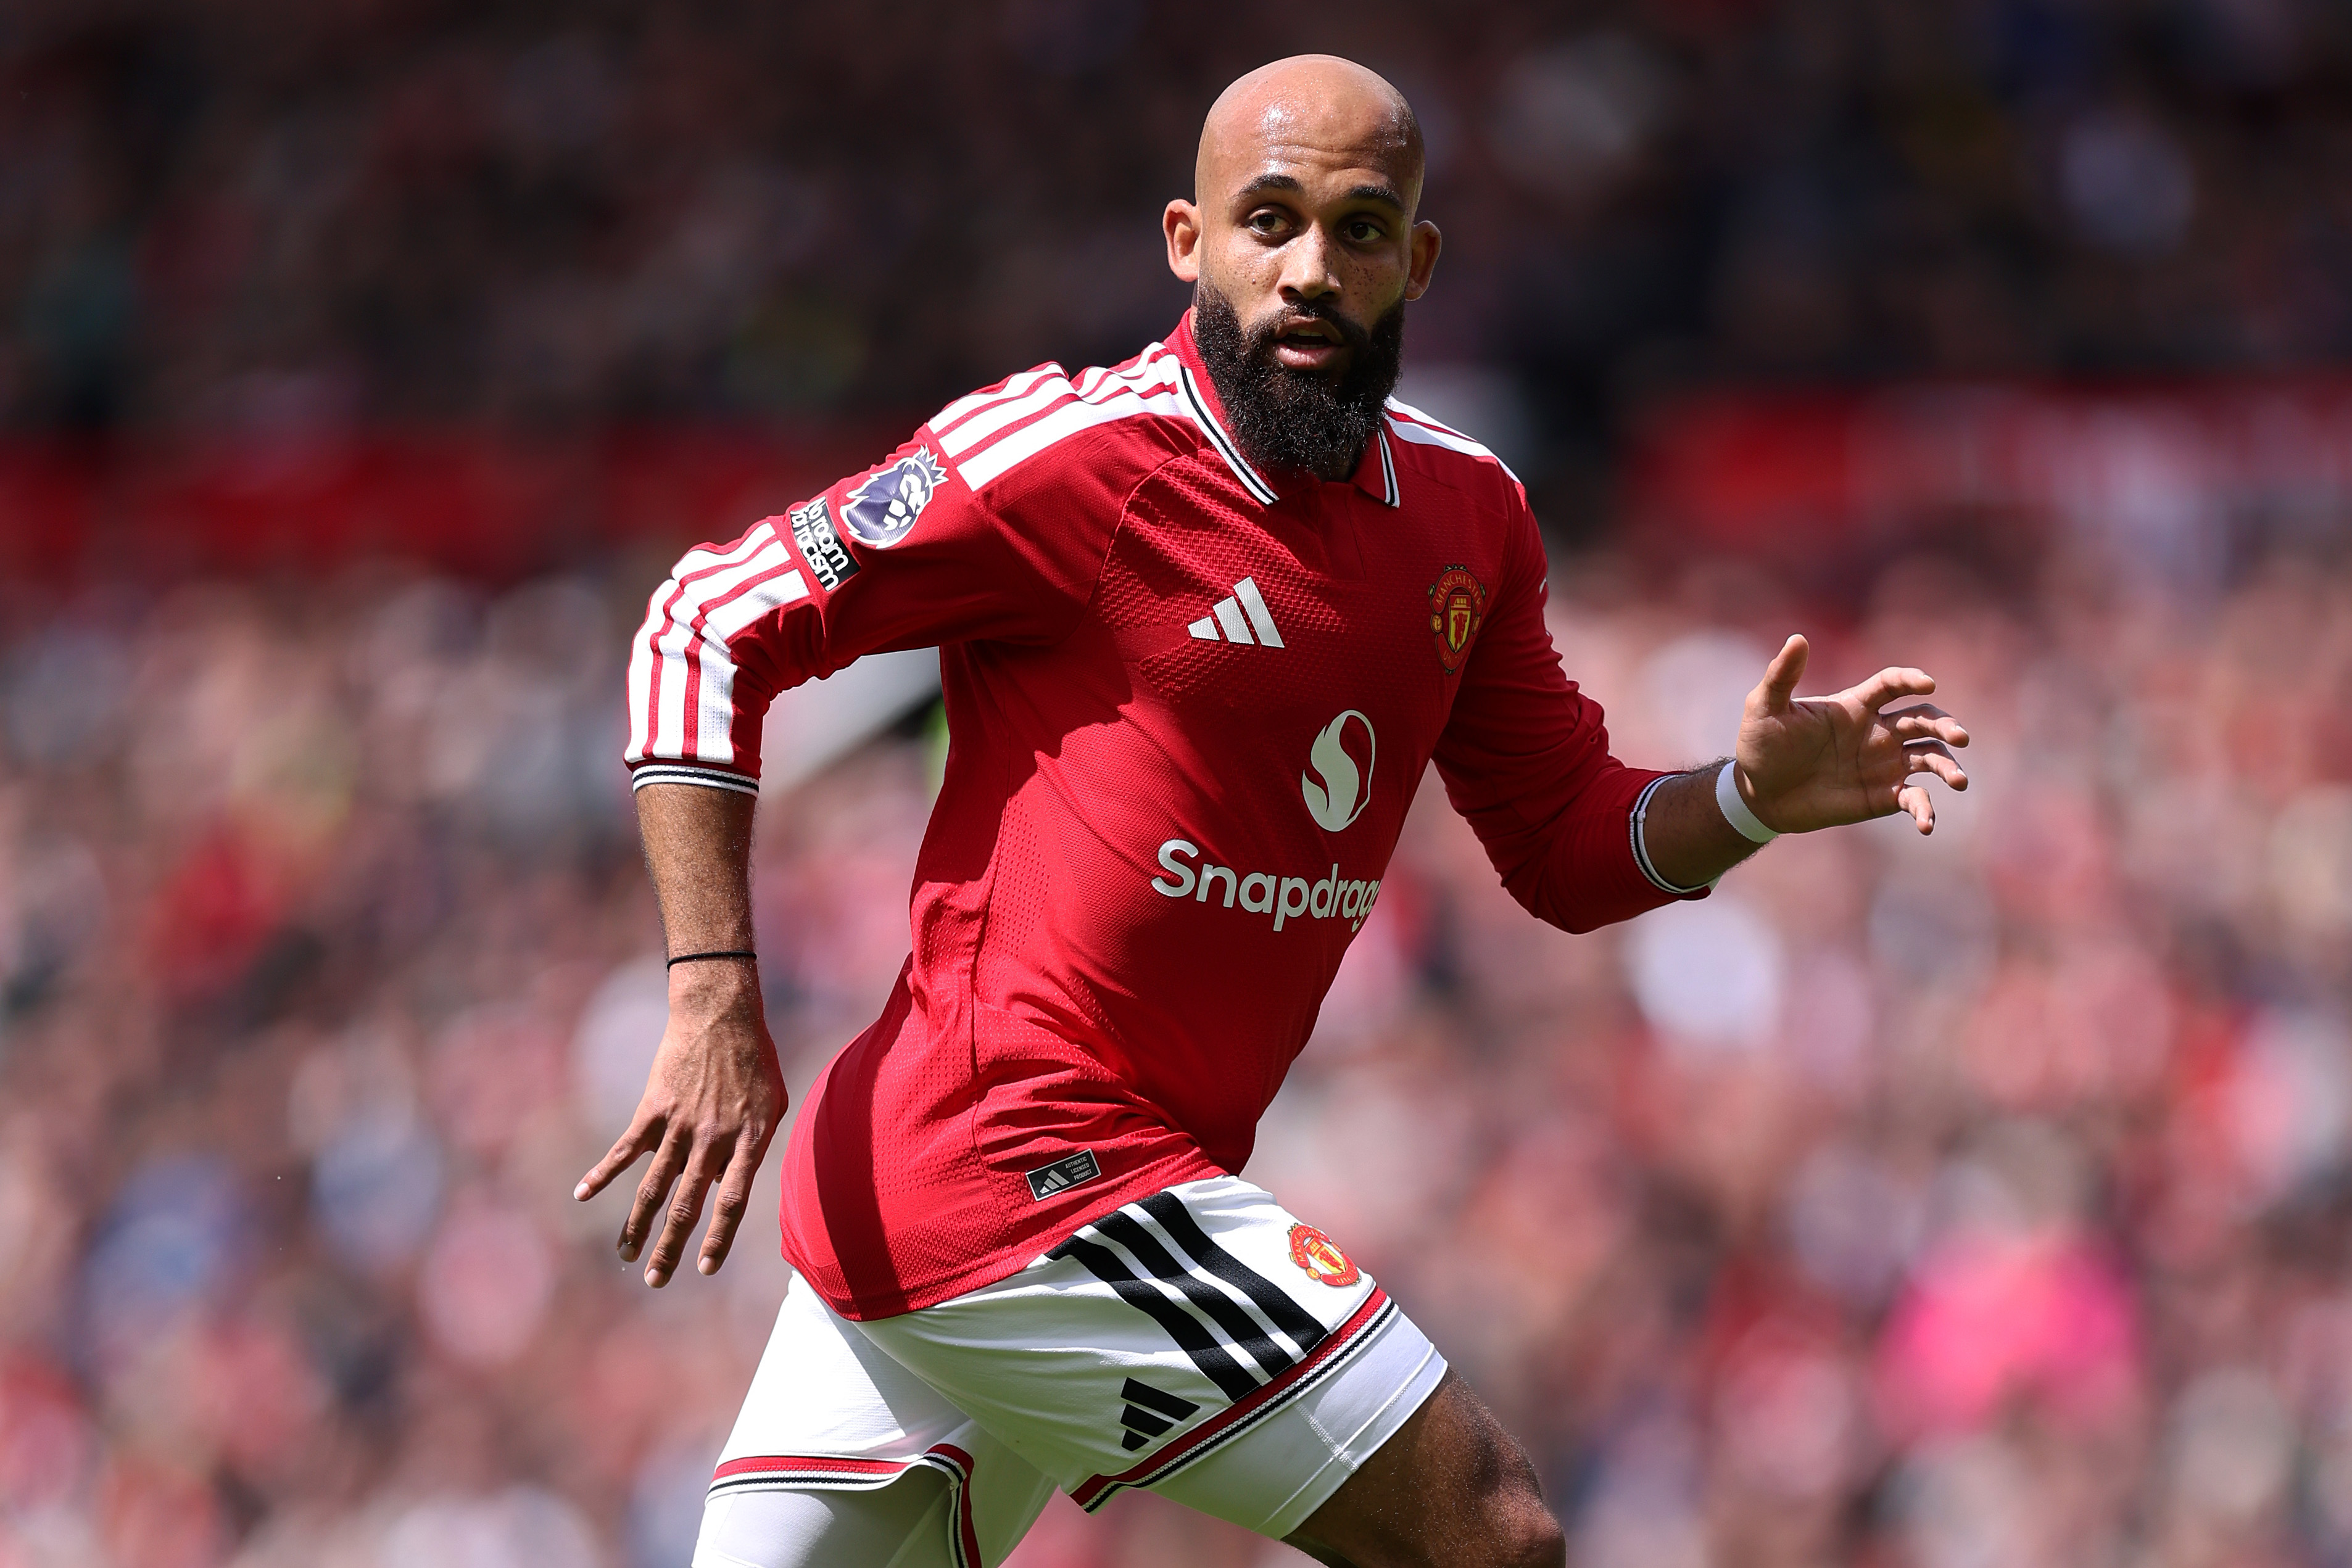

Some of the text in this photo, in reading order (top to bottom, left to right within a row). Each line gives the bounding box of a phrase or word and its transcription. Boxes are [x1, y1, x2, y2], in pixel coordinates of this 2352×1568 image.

[794, 524, 840, 592] racism
[811, 515, 849, 572] room
[1151, 839, 1383, 932] Snapdrag
[1065, 1157, 1087, 1168] AUTHENTIC
[1070, 1163, 1090, 1174] LICENSED
[1074, 1169, 1091, 1181] PRODUCT
